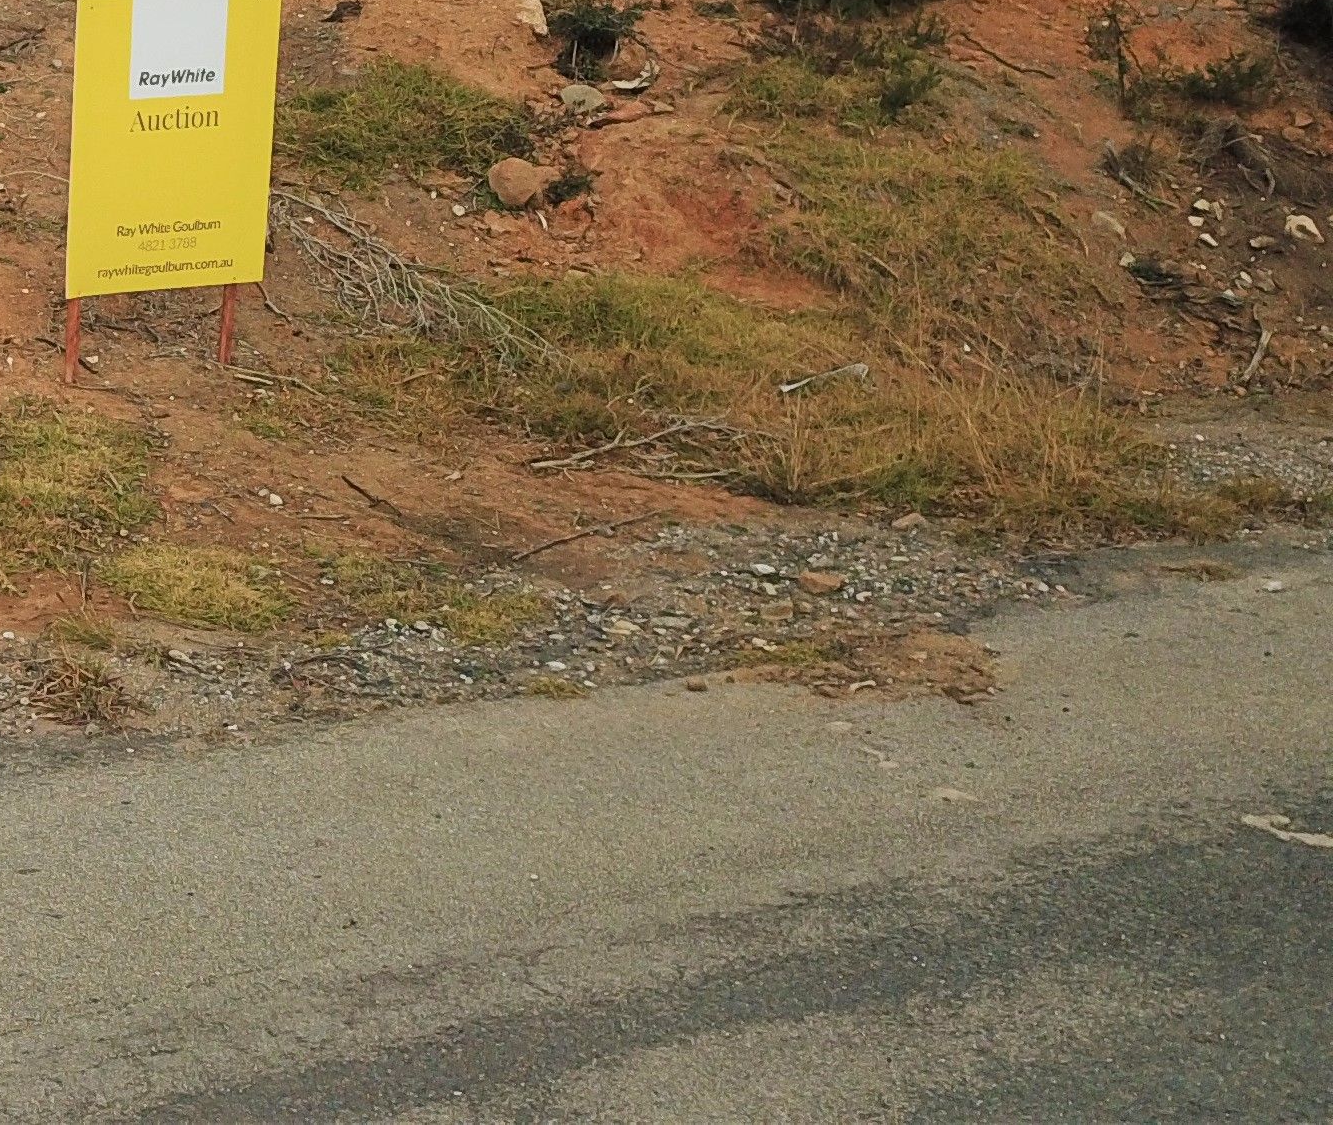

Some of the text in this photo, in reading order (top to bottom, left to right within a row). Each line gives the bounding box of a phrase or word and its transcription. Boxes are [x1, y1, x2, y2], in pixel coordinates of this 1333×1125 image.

[129, 105, 219, 133] Auction
[116, 219, 221, 238] Ray White Goulburn
[137, 239, 166, 252] 4821
[97, 259, 233, 279] raywhitegoulburn.com.au
